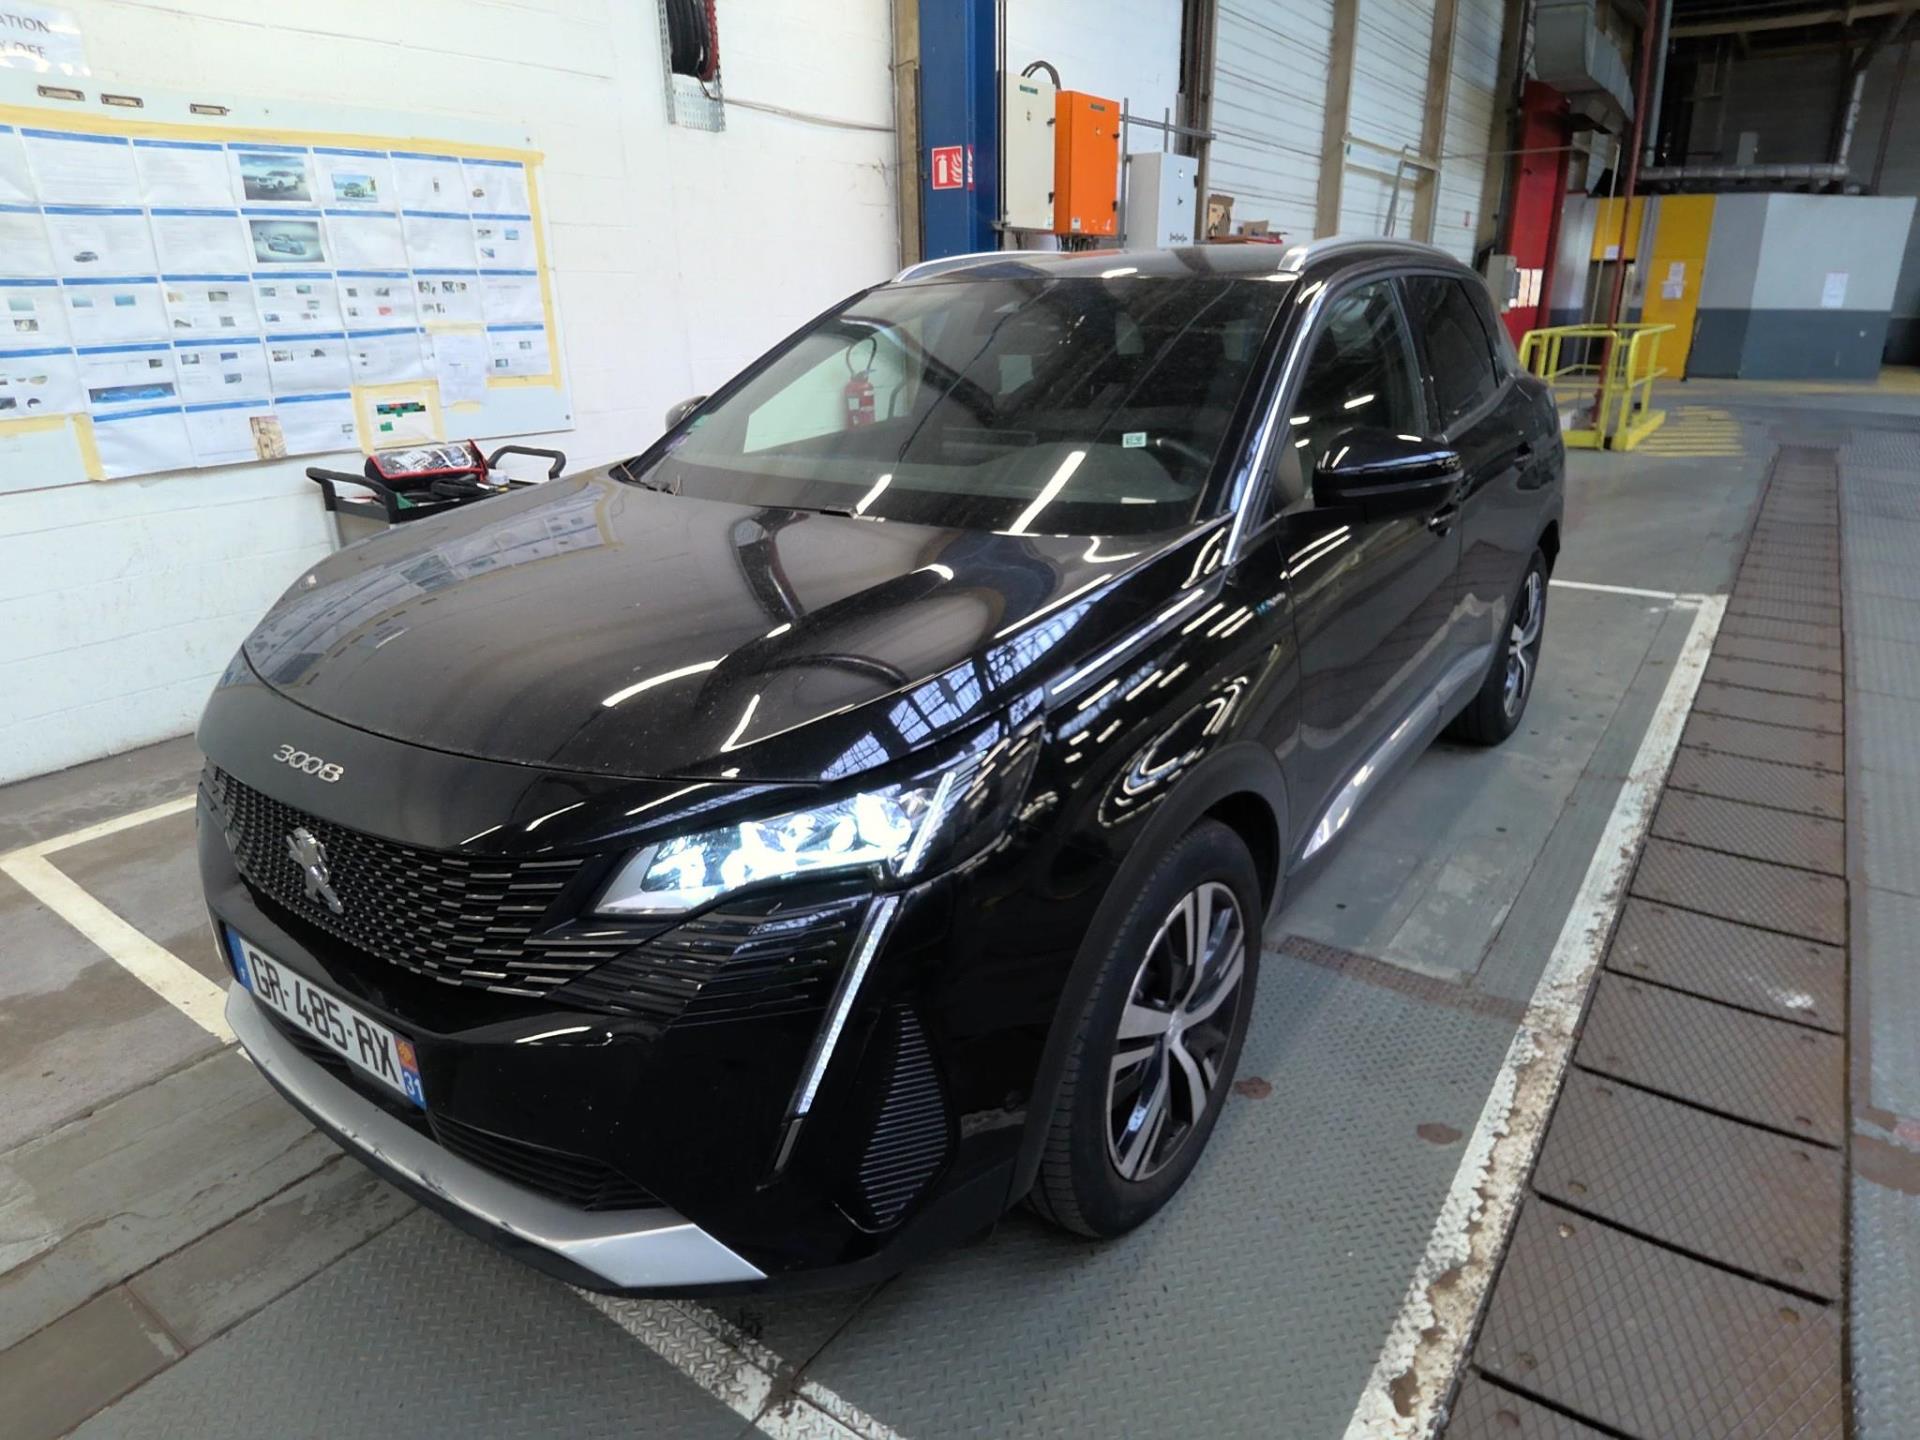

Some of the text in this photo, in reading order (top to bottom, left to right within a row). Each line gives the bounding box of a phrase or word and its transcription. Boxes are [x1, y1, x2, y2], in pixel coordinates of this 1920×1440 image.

[273, 744, 344, 783] 3008
[249, 951, 399, 1084] GR-485-RX
[403, 1070, 425, 1102] 31
